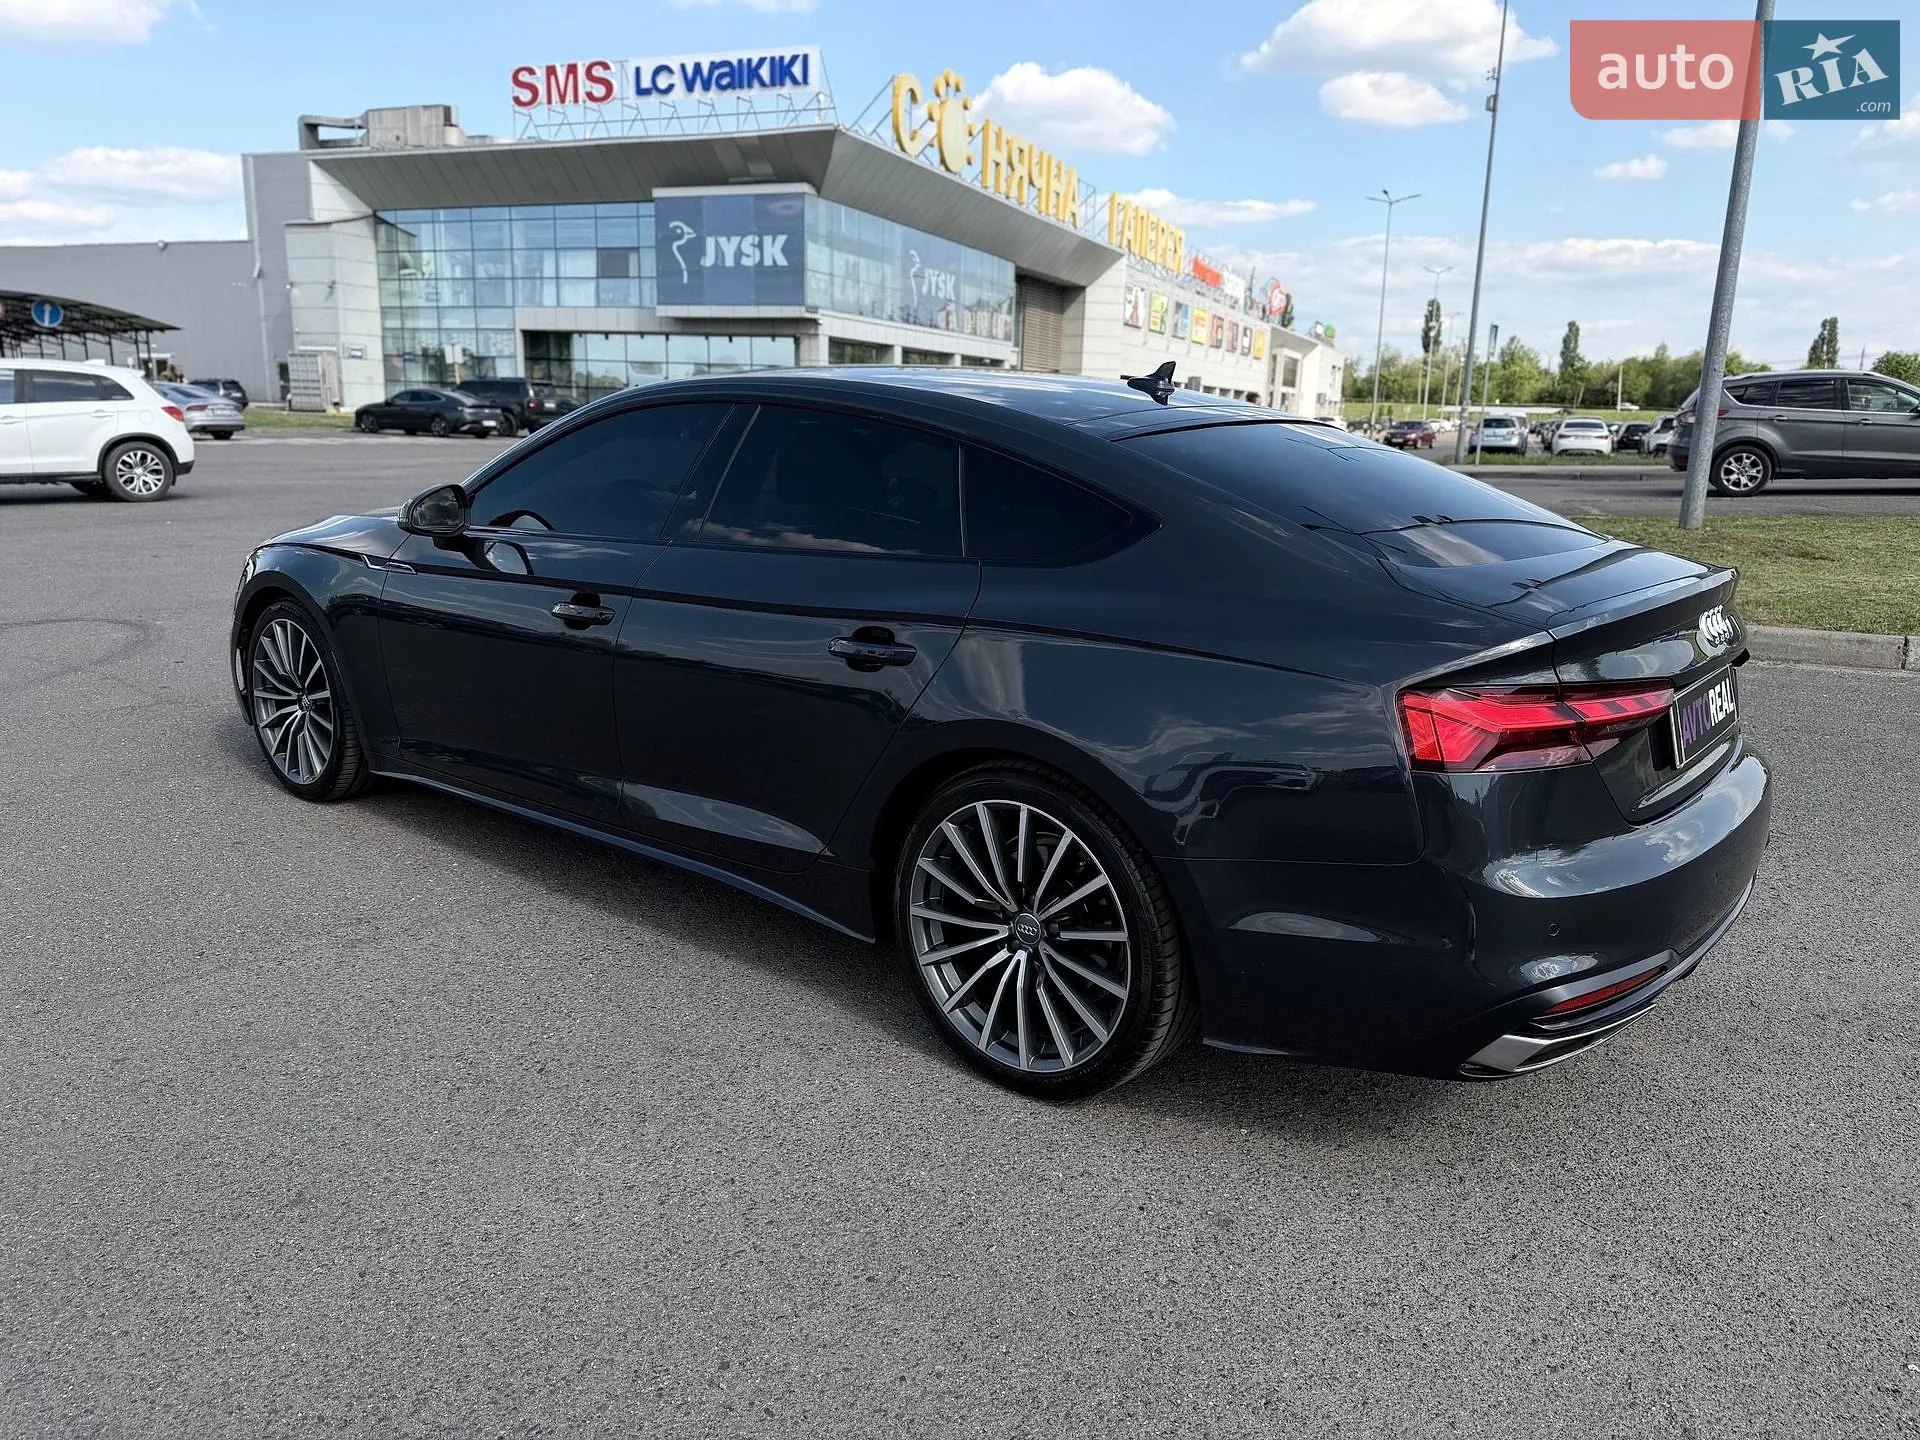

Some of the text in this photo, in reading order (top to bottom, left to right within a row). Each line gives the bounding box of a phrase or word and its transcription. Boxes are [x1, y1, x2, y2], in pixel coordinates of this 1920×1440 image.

[511, 60, 615, 109] SMS
[634, 64, 675, 96] LC
[701, 234, 789, 267] JYSK
[922, 267, 956, 300] JYSK
